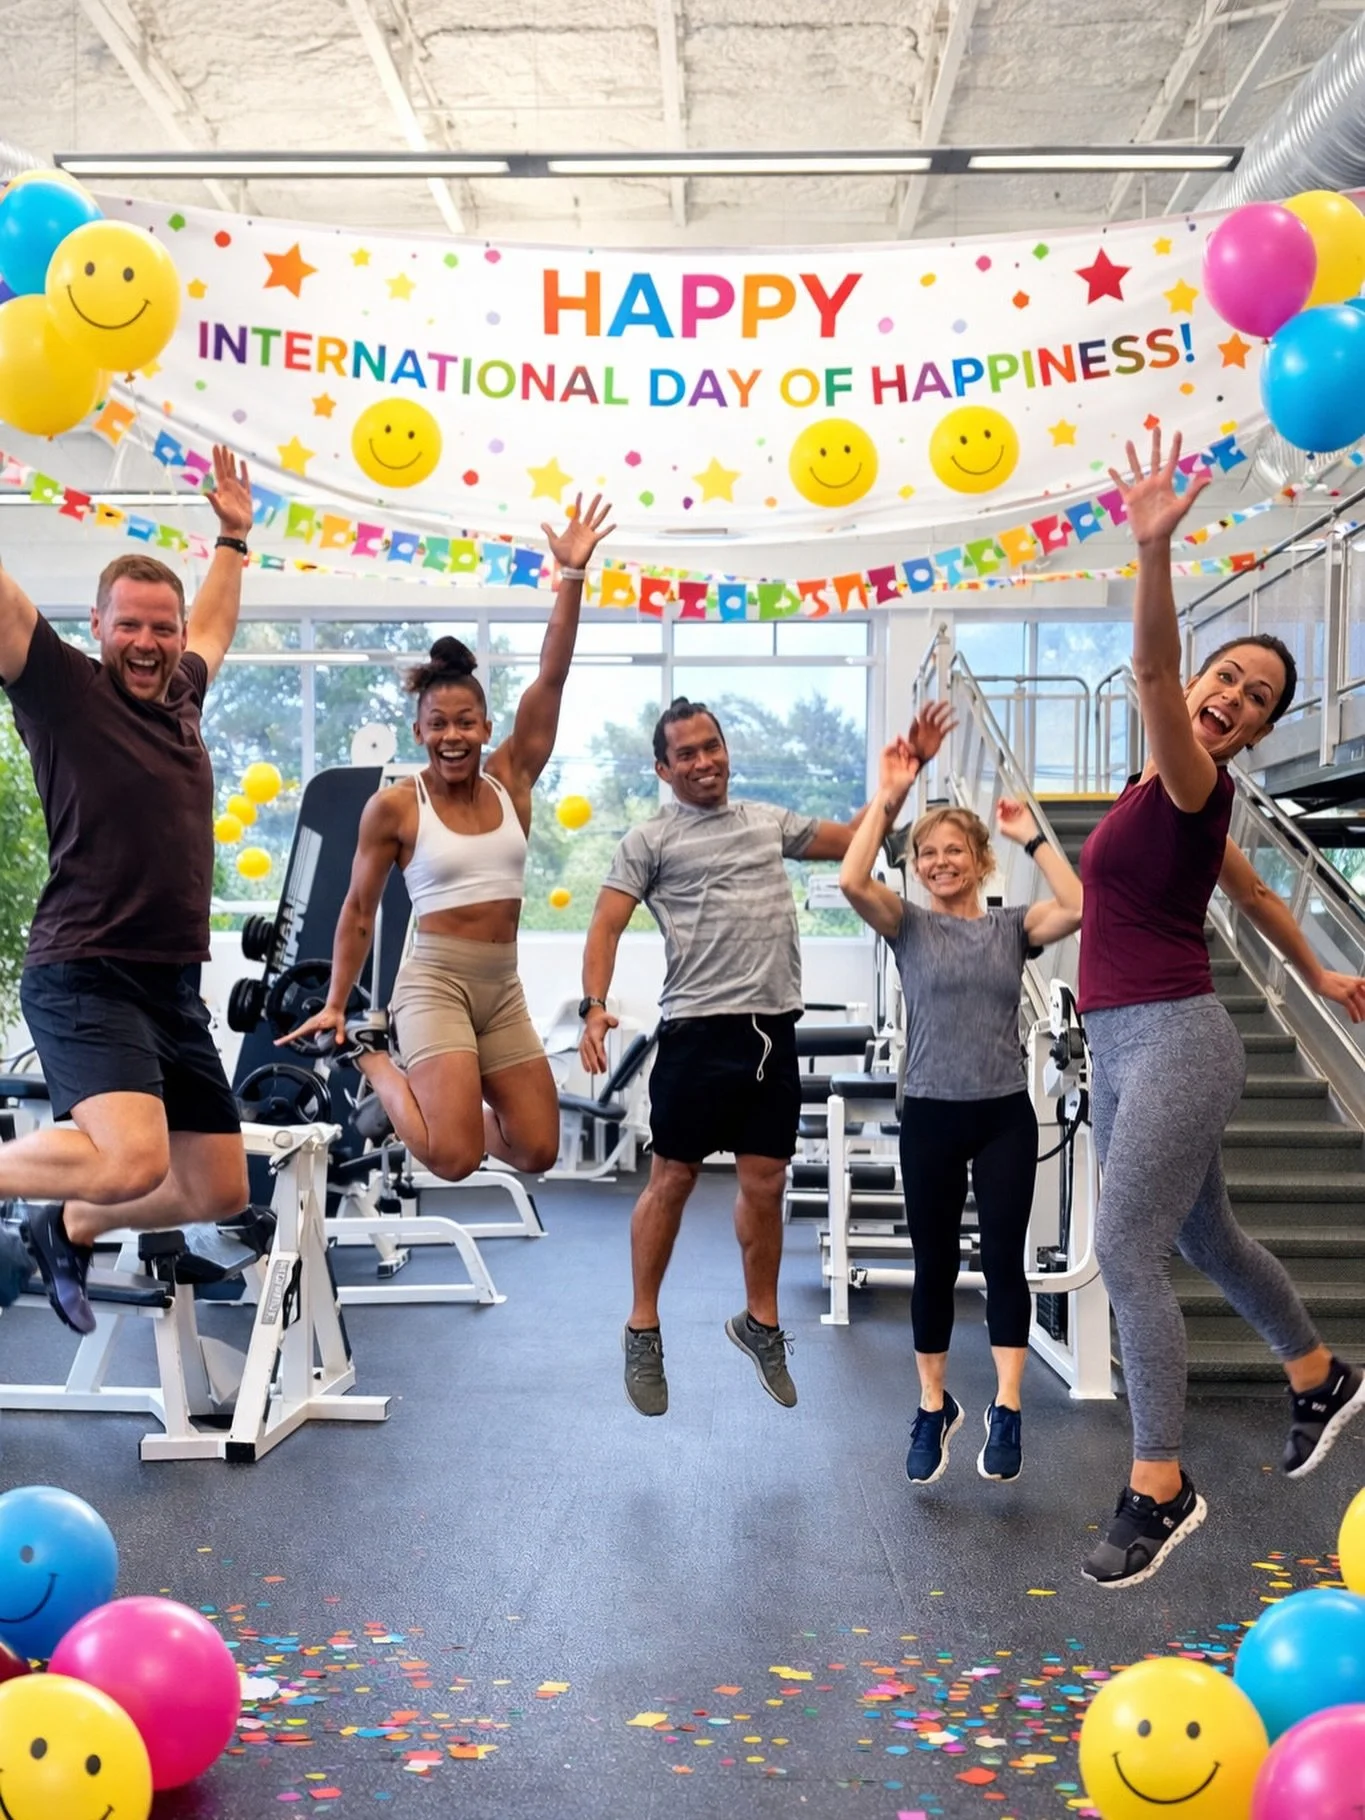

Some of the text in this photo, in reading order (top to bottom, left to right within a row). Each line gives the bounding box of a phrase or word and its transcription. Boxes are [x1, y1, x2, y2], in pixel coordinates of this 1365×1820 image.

[543, 268, 863, 339] HAPPY
[199, 321, 1196, 408] INTERNATIONAL DAY OF HAPPINESS!
